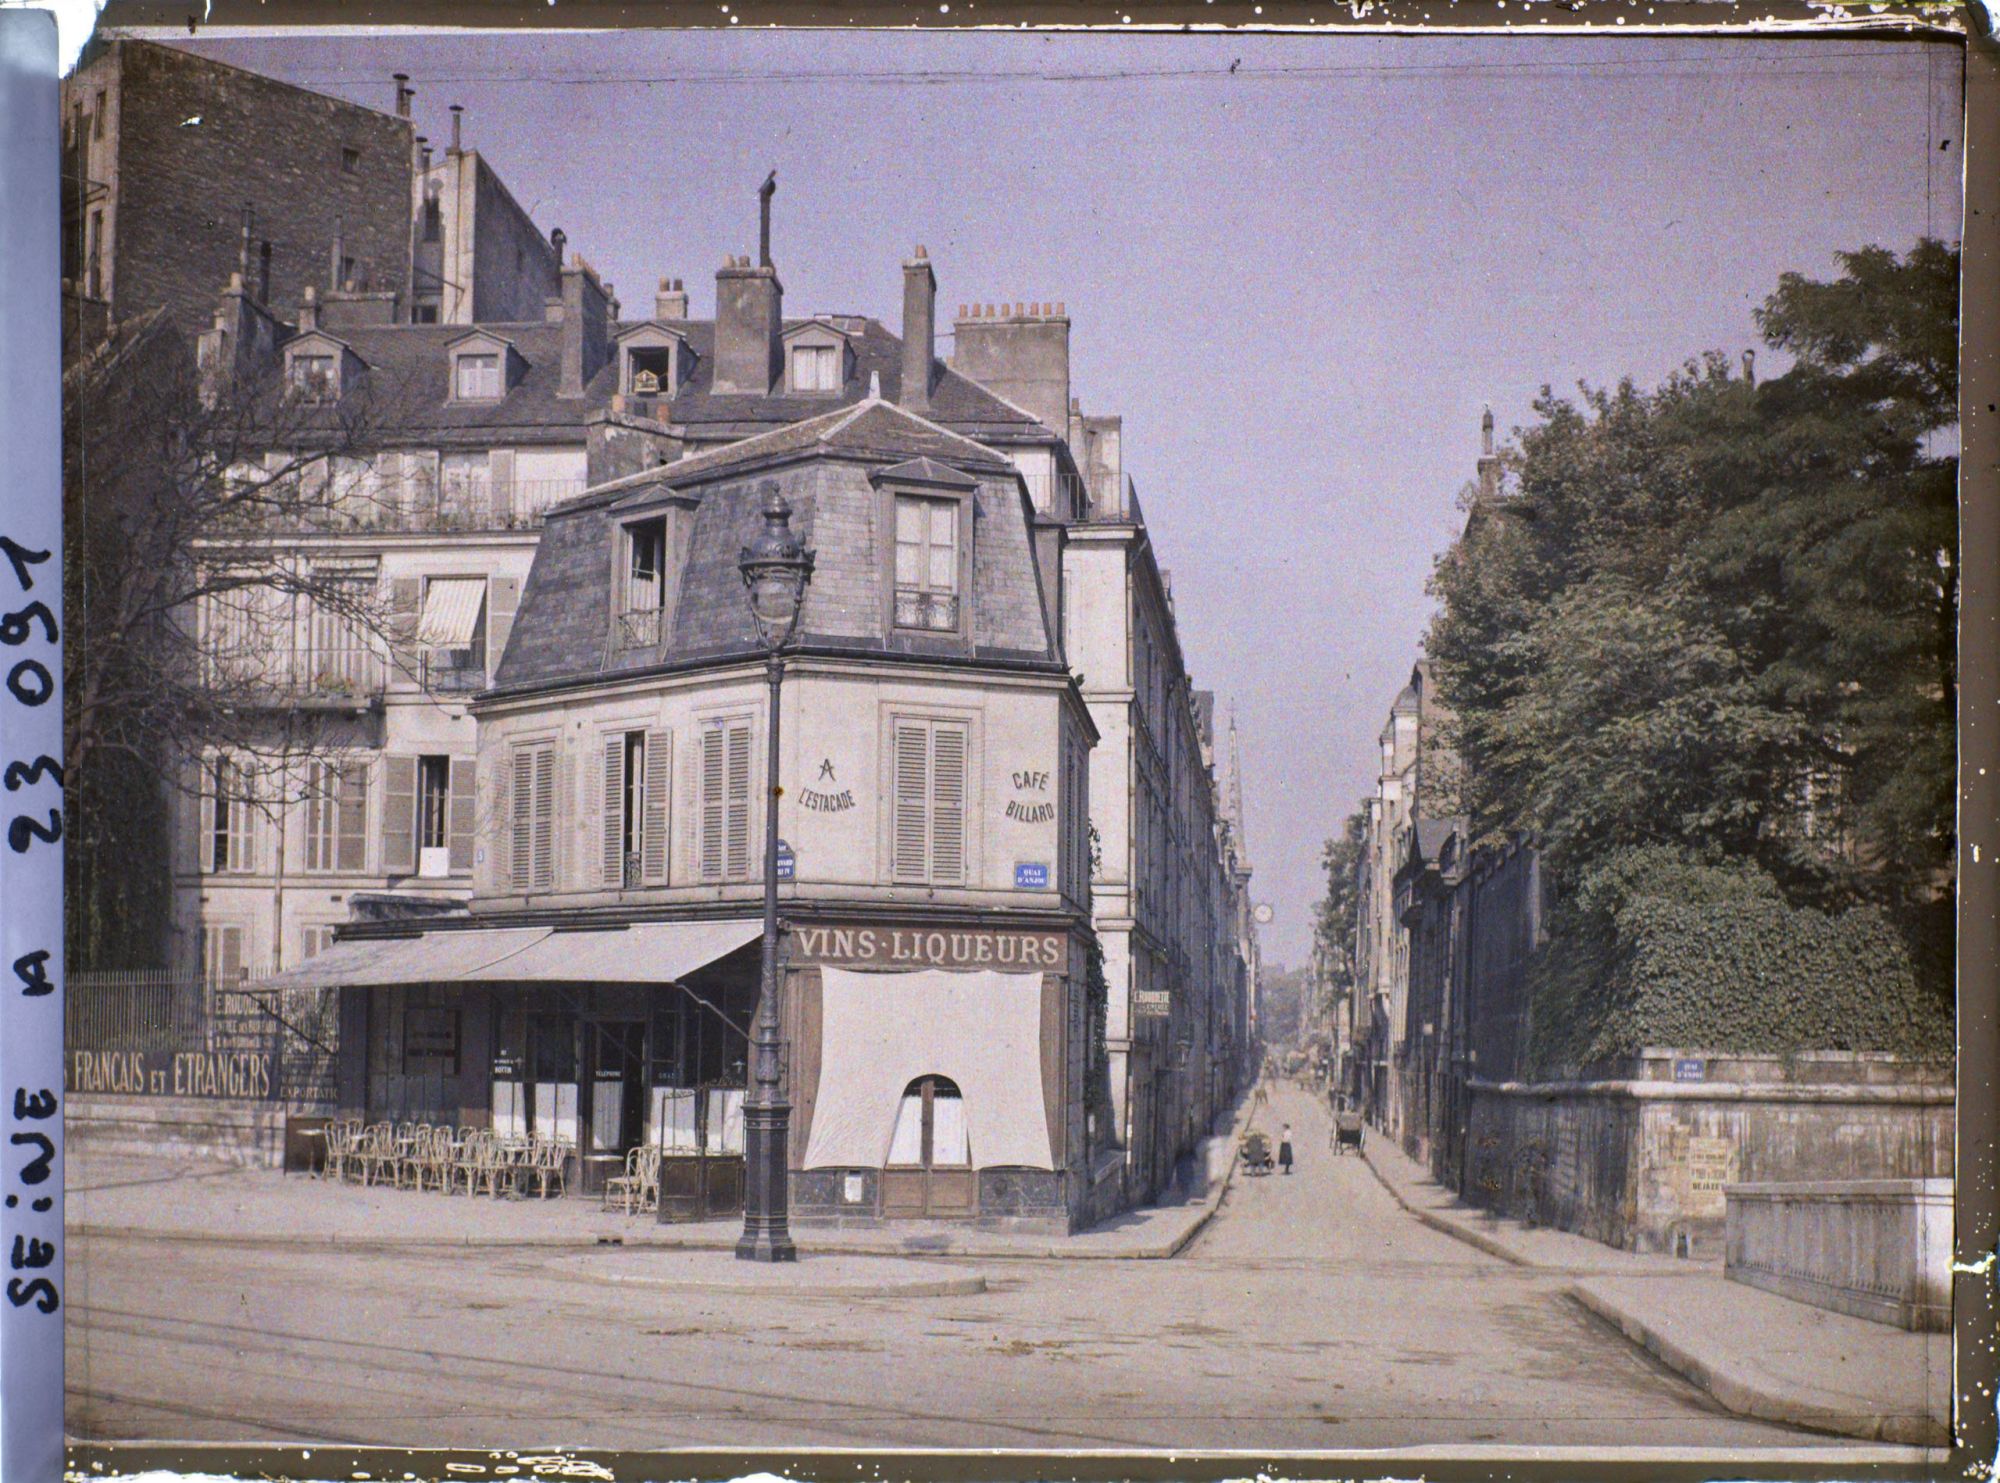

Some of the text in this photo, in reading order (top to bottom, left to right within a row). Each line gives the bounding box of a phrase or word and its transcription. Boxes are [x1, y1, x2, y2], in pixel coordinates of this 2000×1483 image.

[818, 758, 836, 782] A
[1012, 771, 1050, 791] CAFÉ
[799, 787, 855, 812] L'ESTACADE
[1005, 800, 1054, 823] BILLARD
[797, 928, 1060, 965] VINS LIQUEURS
[12, 949, 55, 997] A
[150, 1071, 167, 1094] ET
[173, 1053, 270, 1097] ETRANGERS
